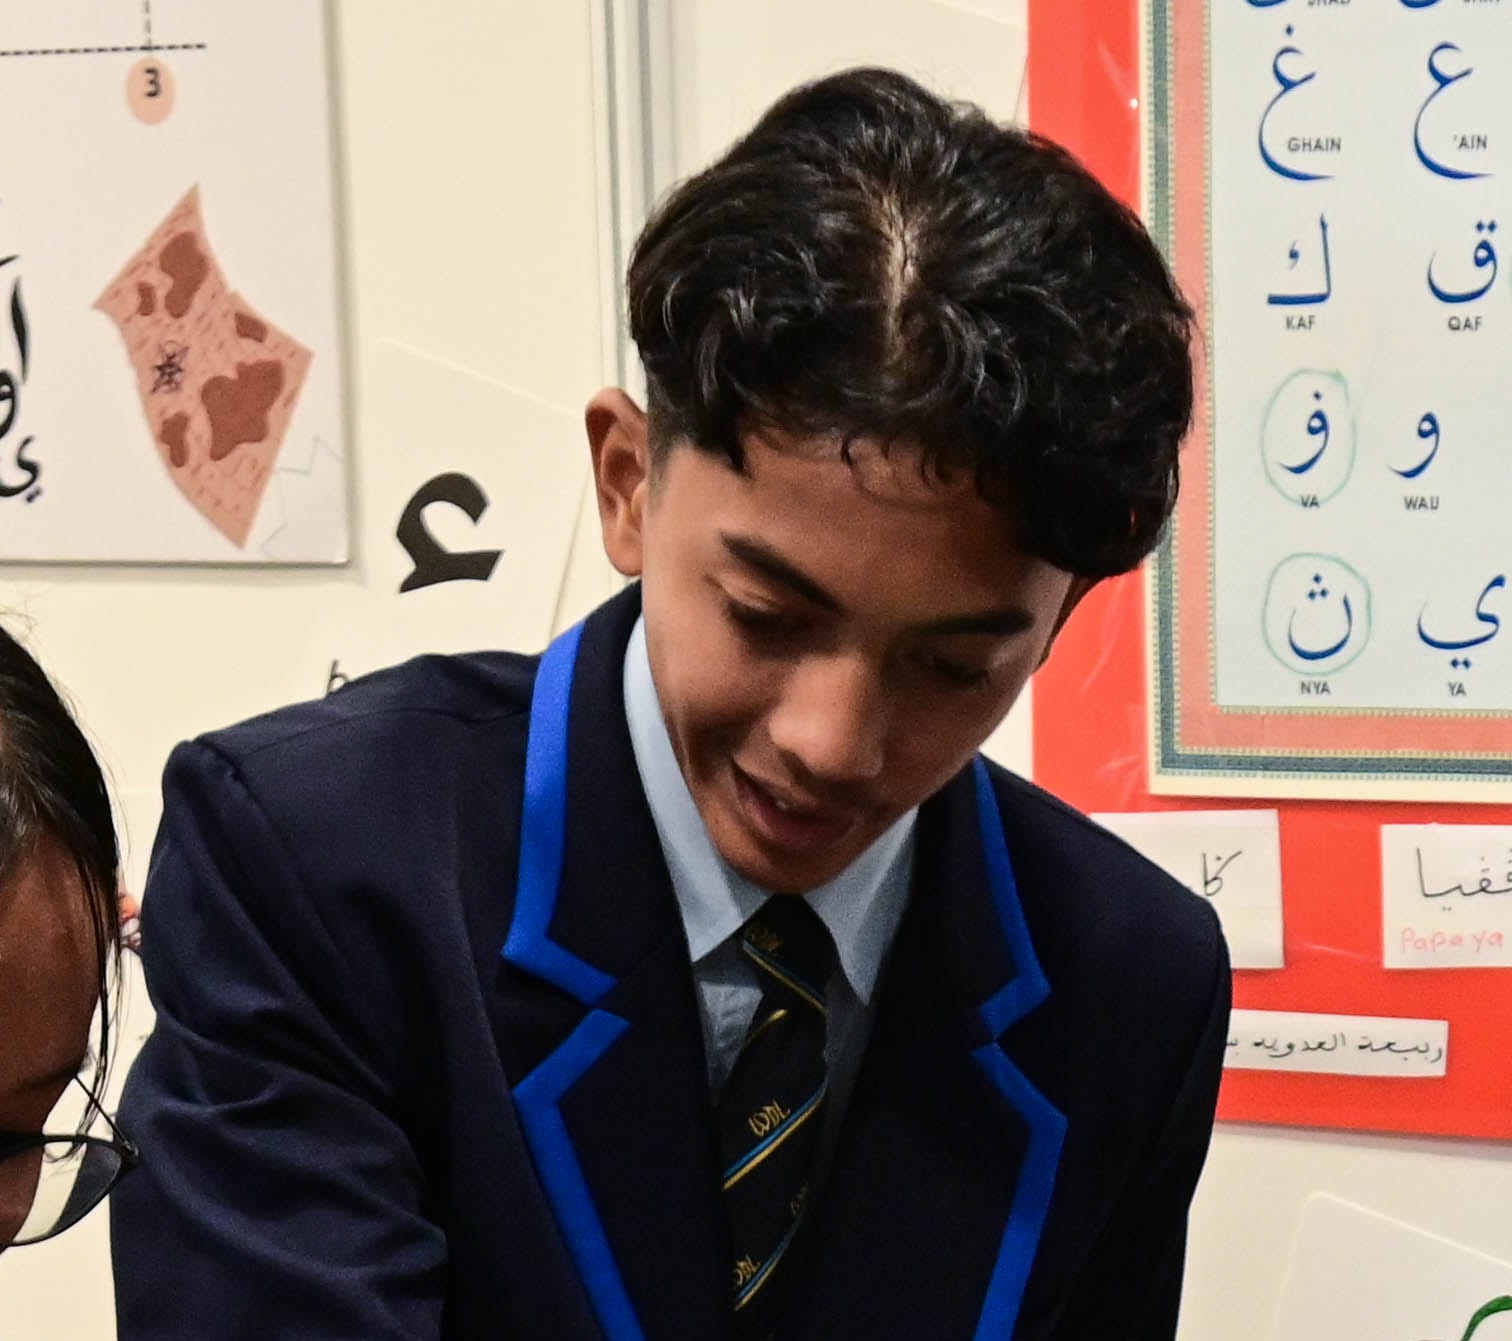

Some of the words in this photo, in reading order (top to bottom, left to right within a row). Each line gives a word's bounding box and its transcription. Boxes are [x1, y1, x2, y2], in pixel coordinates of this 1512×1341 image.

[1259, 25, 1335, 181] غ
[1414, 41, 1492, 181] ع
[1287, 136, 1342, 153] GHAIN
[1452, 134, 1488, 151] 'AIN
[1428, 220, 1497, 304] ق
[1446, 315, 1484, 332] QAF
[1388, 410, 1442, 478] و
[1299, 494, 1321, 511] VA
[1402, 494, 1441, 512] WAU
[1416, 572, 1507, 672] ي
[1299, 679, 1332, 696] NYA
[1446, 680, 1468, 698] YA
